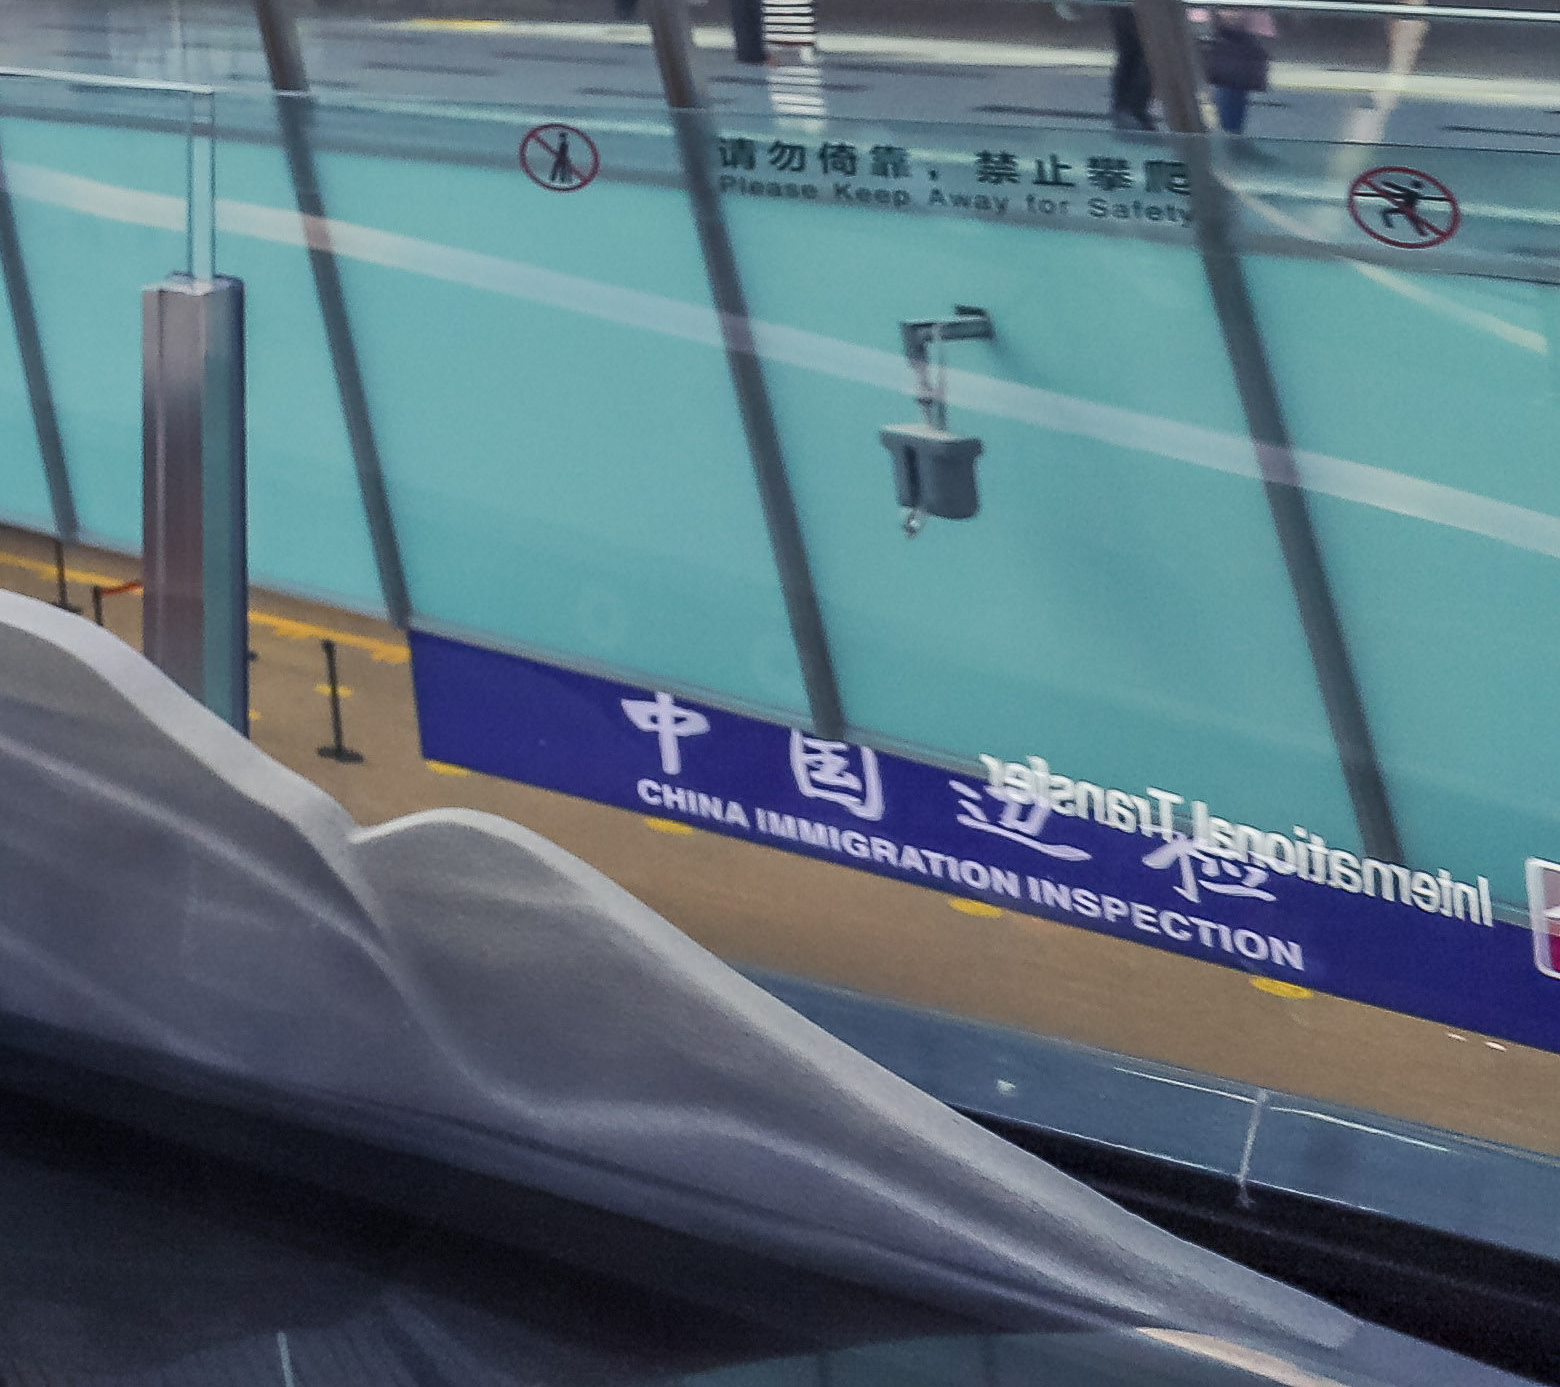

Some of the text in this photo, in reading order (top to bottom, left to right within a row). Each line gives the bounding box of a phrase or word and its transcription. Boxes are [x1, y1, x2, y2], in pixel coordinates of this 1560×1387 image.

[719, 174, 1192, 227] Please Keep Away for Safety
[636, 778, 1305, 971] CHINA IMMIGRATION INSPECTION
